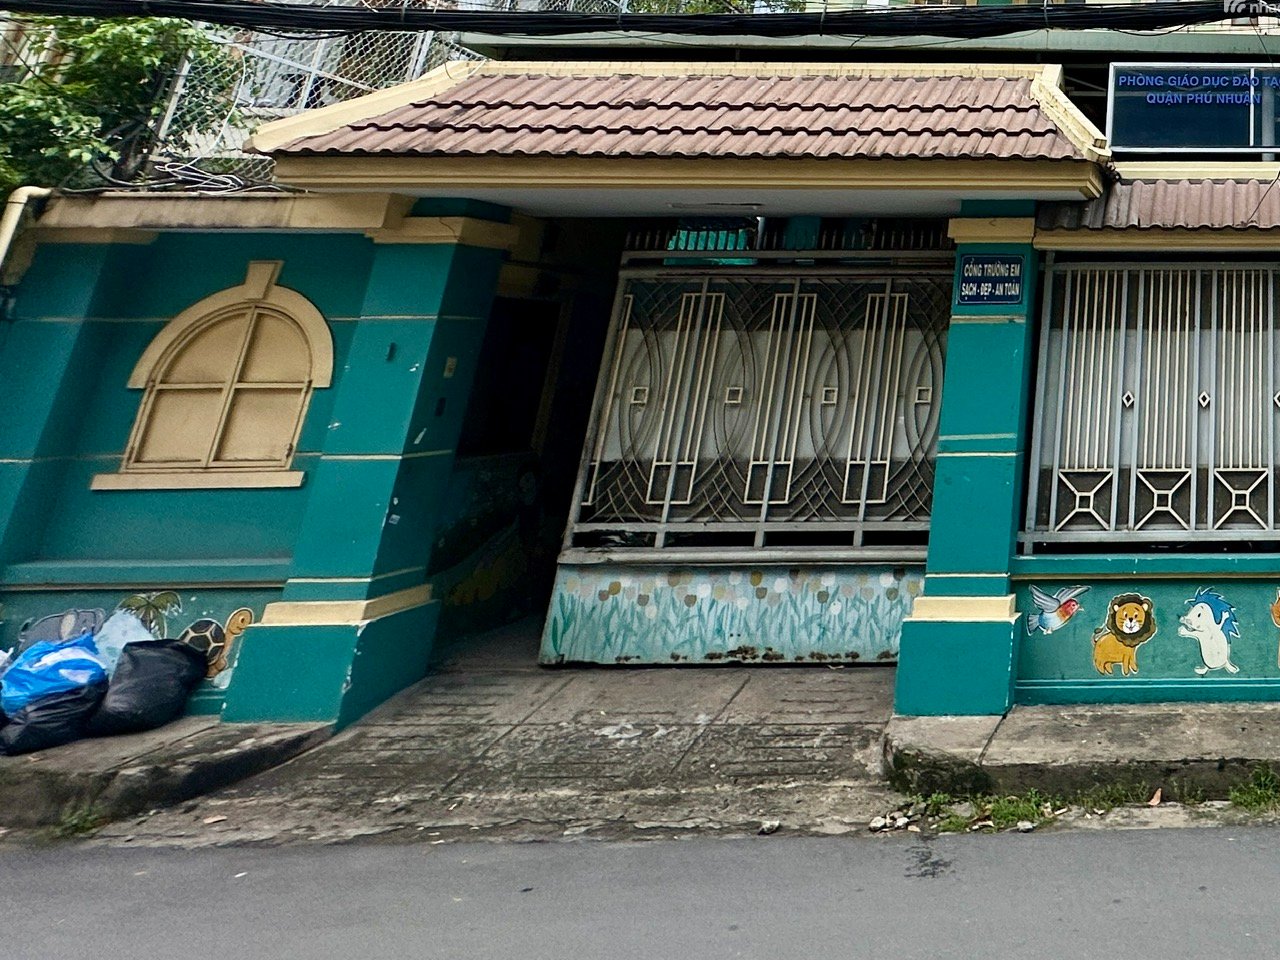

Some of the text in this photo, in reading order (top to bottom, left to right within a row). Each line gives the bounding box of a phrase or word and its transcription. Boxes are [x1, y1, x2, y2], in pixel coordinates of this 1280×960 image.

[1118, 72, 1164, 87] PHÒNG
[1167, 73, 1199, 87] GIÁO
[1202, 76, 1229, 89] DỤC
[1231, 73, 1260, 87] ĐÀO
[1146, 90, 1261, 106] QUẬN PHÚ NHUẬN
[963, 257, 1021, 277] CỔNG TRƯỜNG EM
[961, 282, 977, 301] SẠCH
[980, 282, 993, 301] ĐẸP
[994, 282, 1004, 296] AN
[1004, 279, 1020, 296] TOÀN
